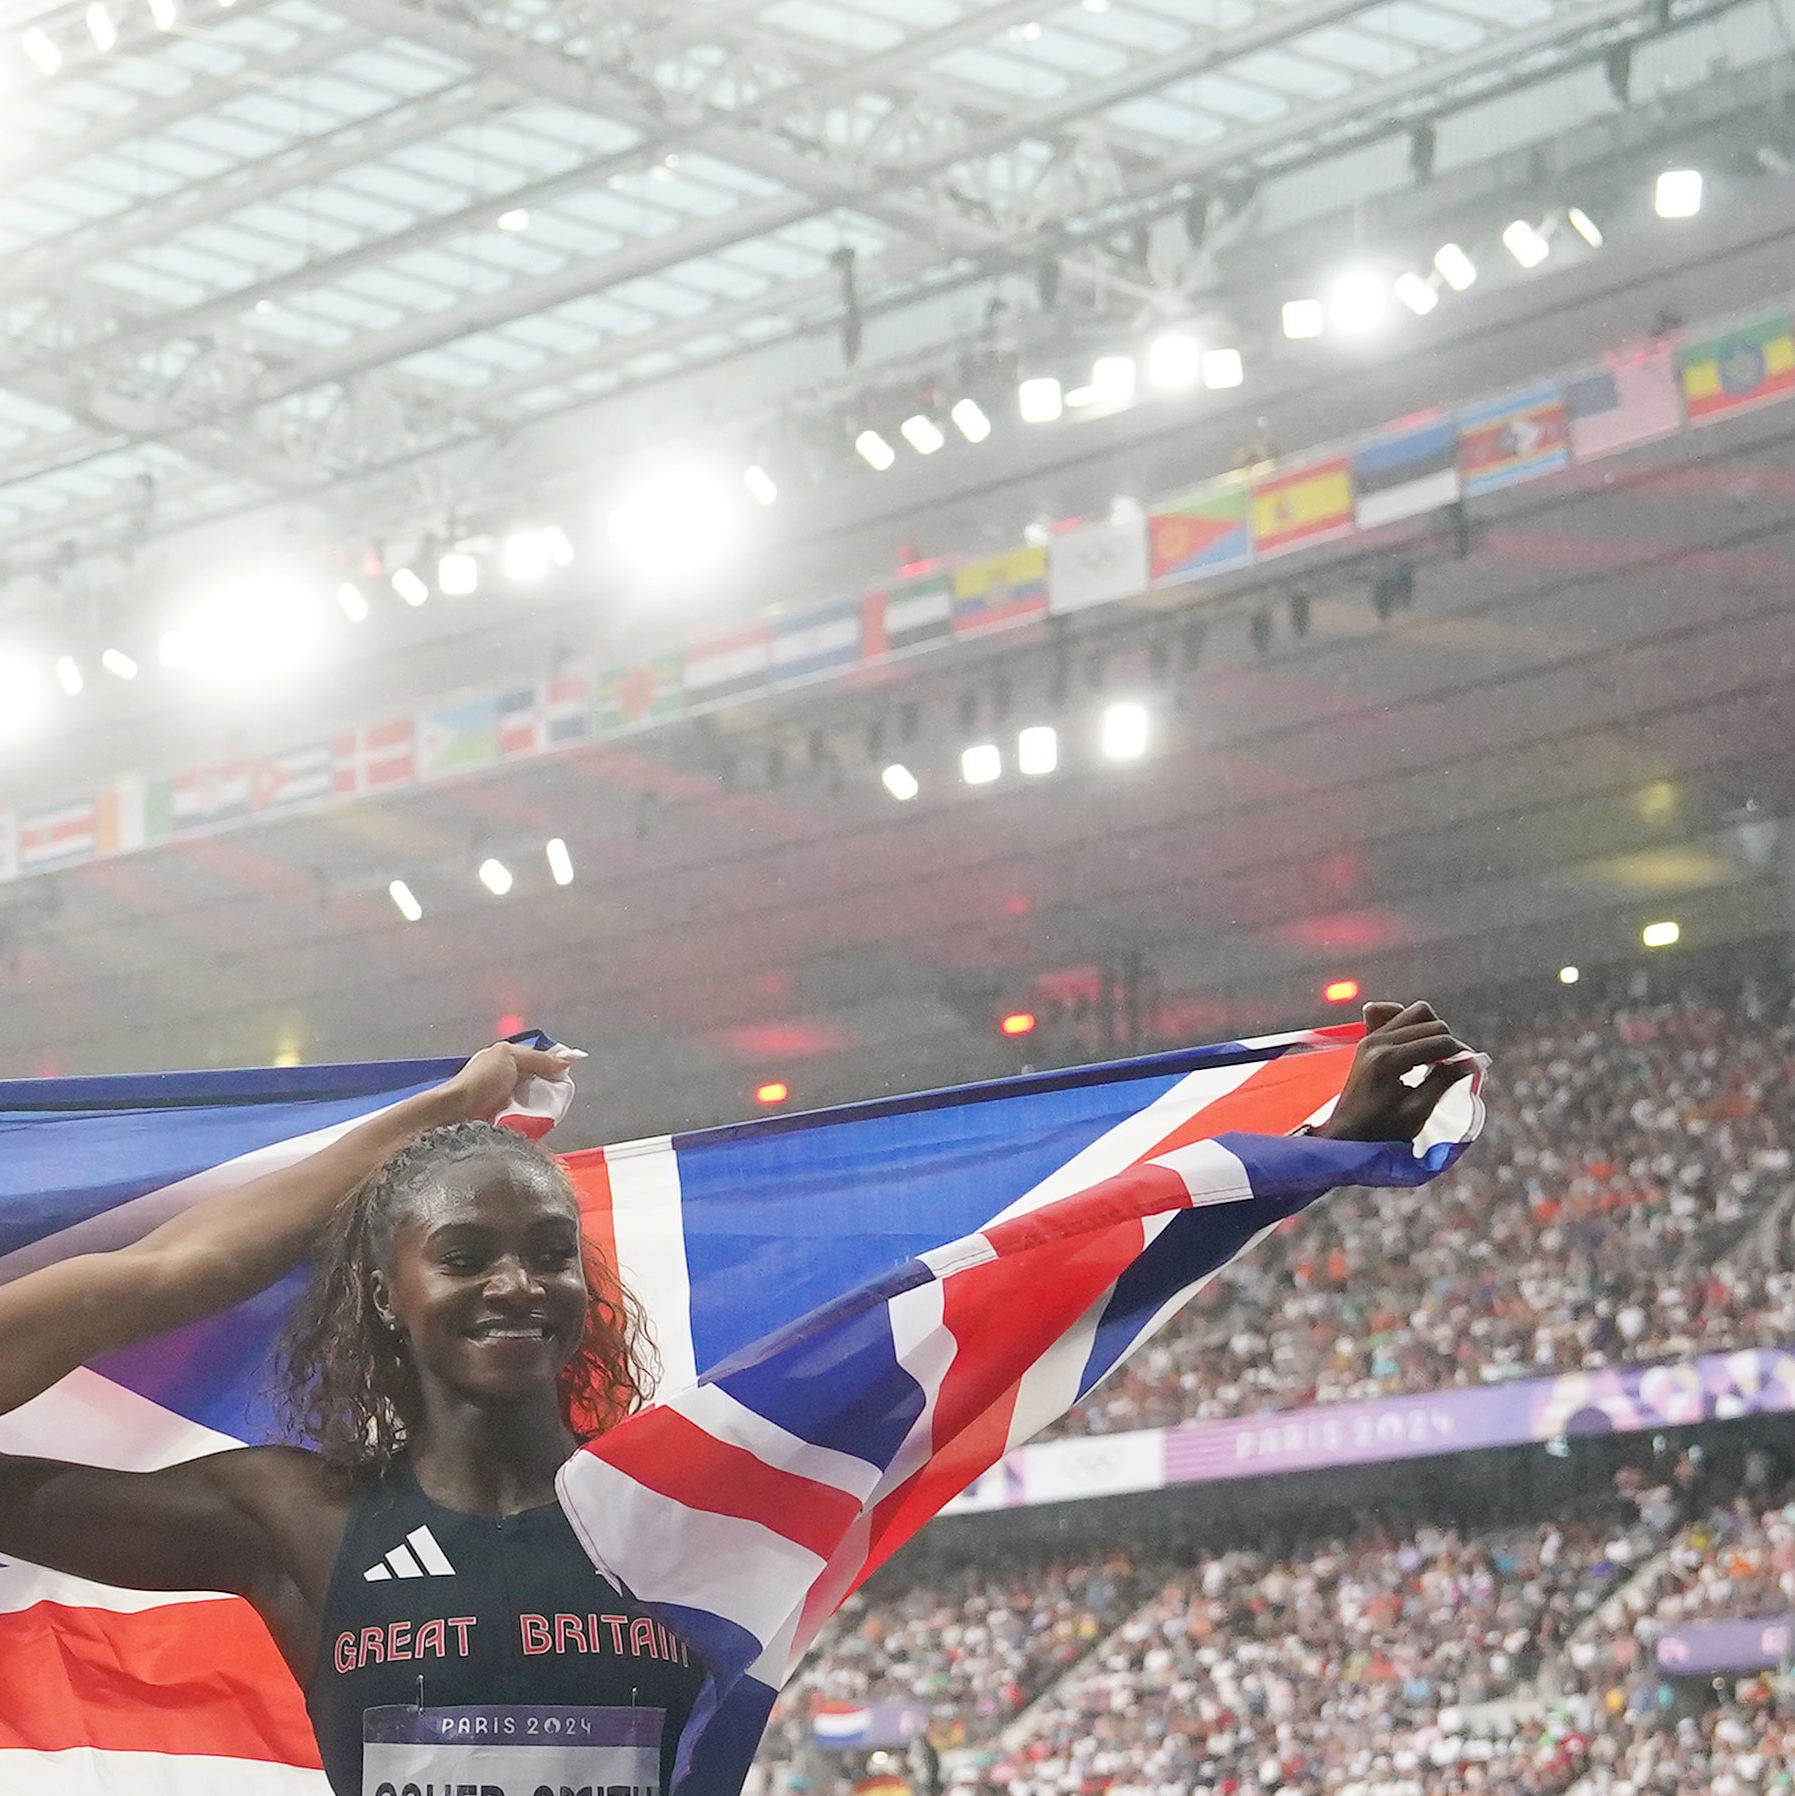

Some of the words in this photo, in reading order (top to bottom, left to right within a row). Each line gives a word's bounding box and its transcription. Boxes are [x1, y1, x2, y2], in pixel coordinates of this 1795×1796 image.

[334, 1616, 478, 1674] GREAT
[520, 1613, 692, 1669] BRITAIN
[442, 1717, 516, 1736] PARIS
[527, 1717, 593, 1736] 2024
